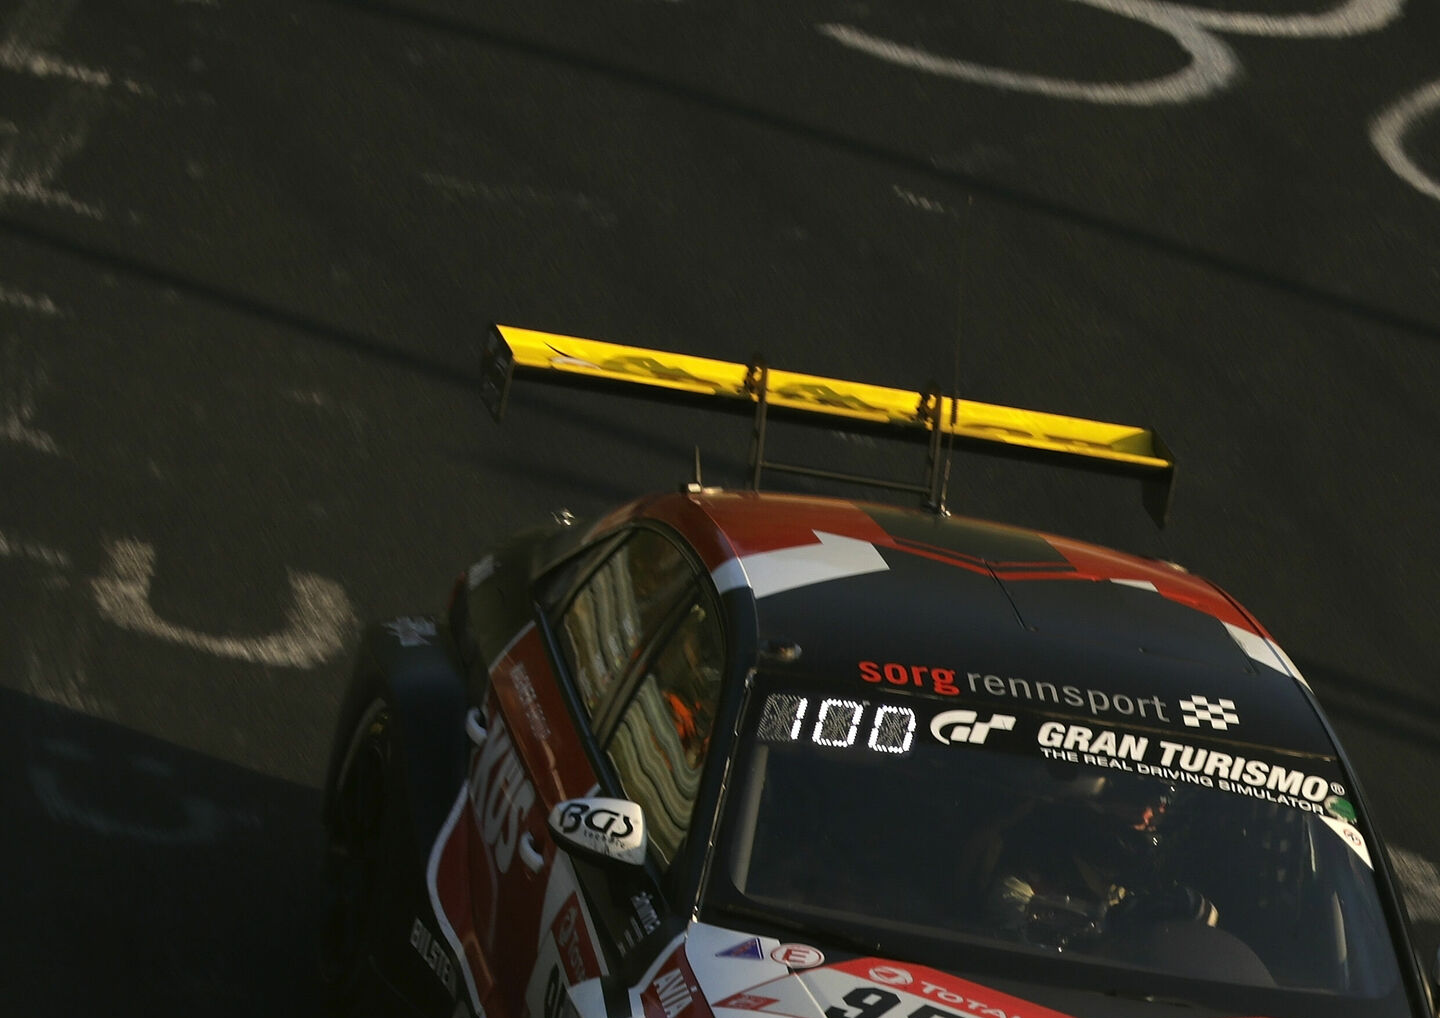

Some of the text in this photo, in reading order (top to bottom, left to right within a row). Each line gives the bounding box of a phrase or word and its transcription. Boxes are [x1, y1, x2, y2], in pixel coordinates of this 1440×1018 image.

[858, 661, 1170, 723] sorg rennsport
[1037, 720, 1329, 803] GRAN TURISMO
[1040, 747, 1325, 816] THE REAL DRIVING SIMULATOR
